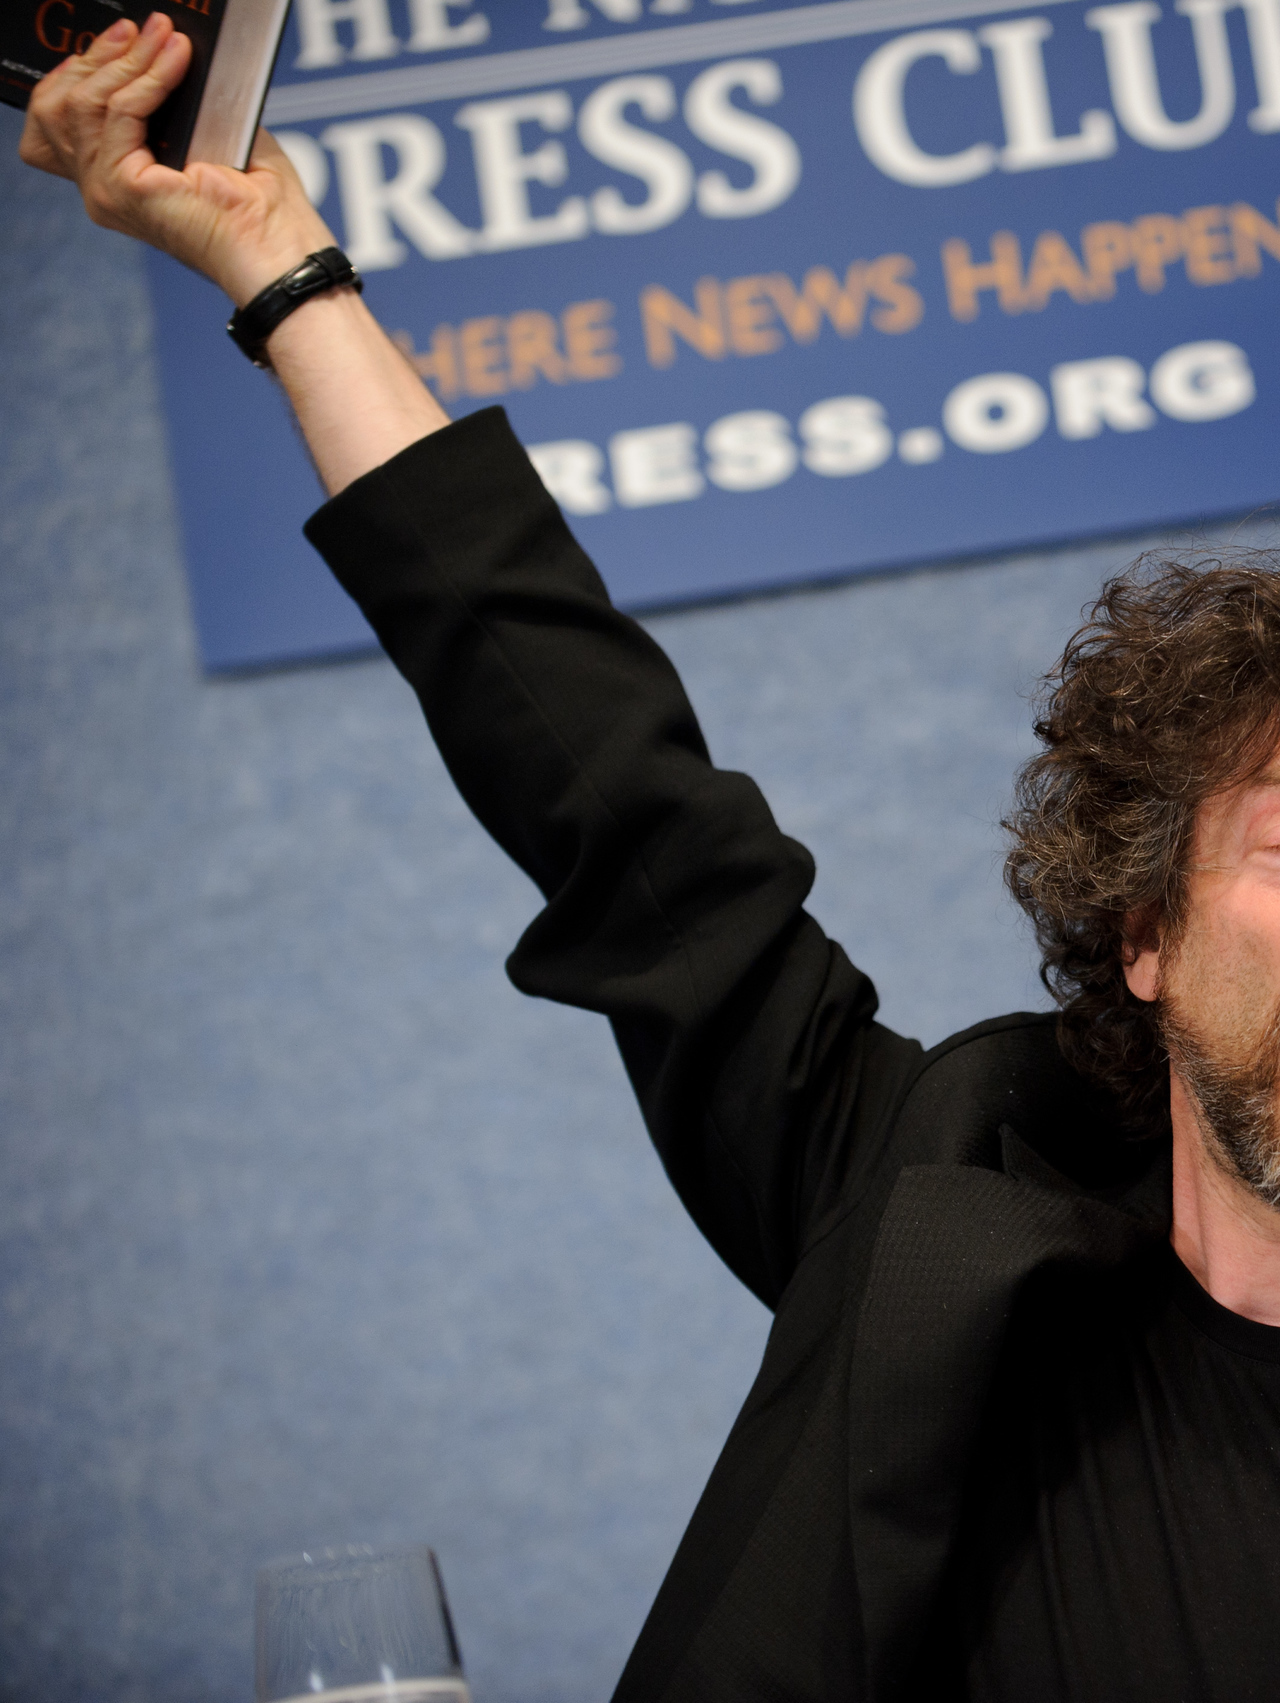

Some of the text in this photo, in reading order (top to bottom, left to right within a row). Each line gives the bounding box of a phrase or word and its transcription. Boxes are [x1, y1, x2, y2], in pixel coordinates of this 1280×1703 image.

[35, 0, 97, 55] Go
[293, 0, 491, 70] HE
[390, 298, 623, 401] HERE
[640, 254, 923, 367] NEWS
[526, 340, 1256, 516] RESS.ORG
